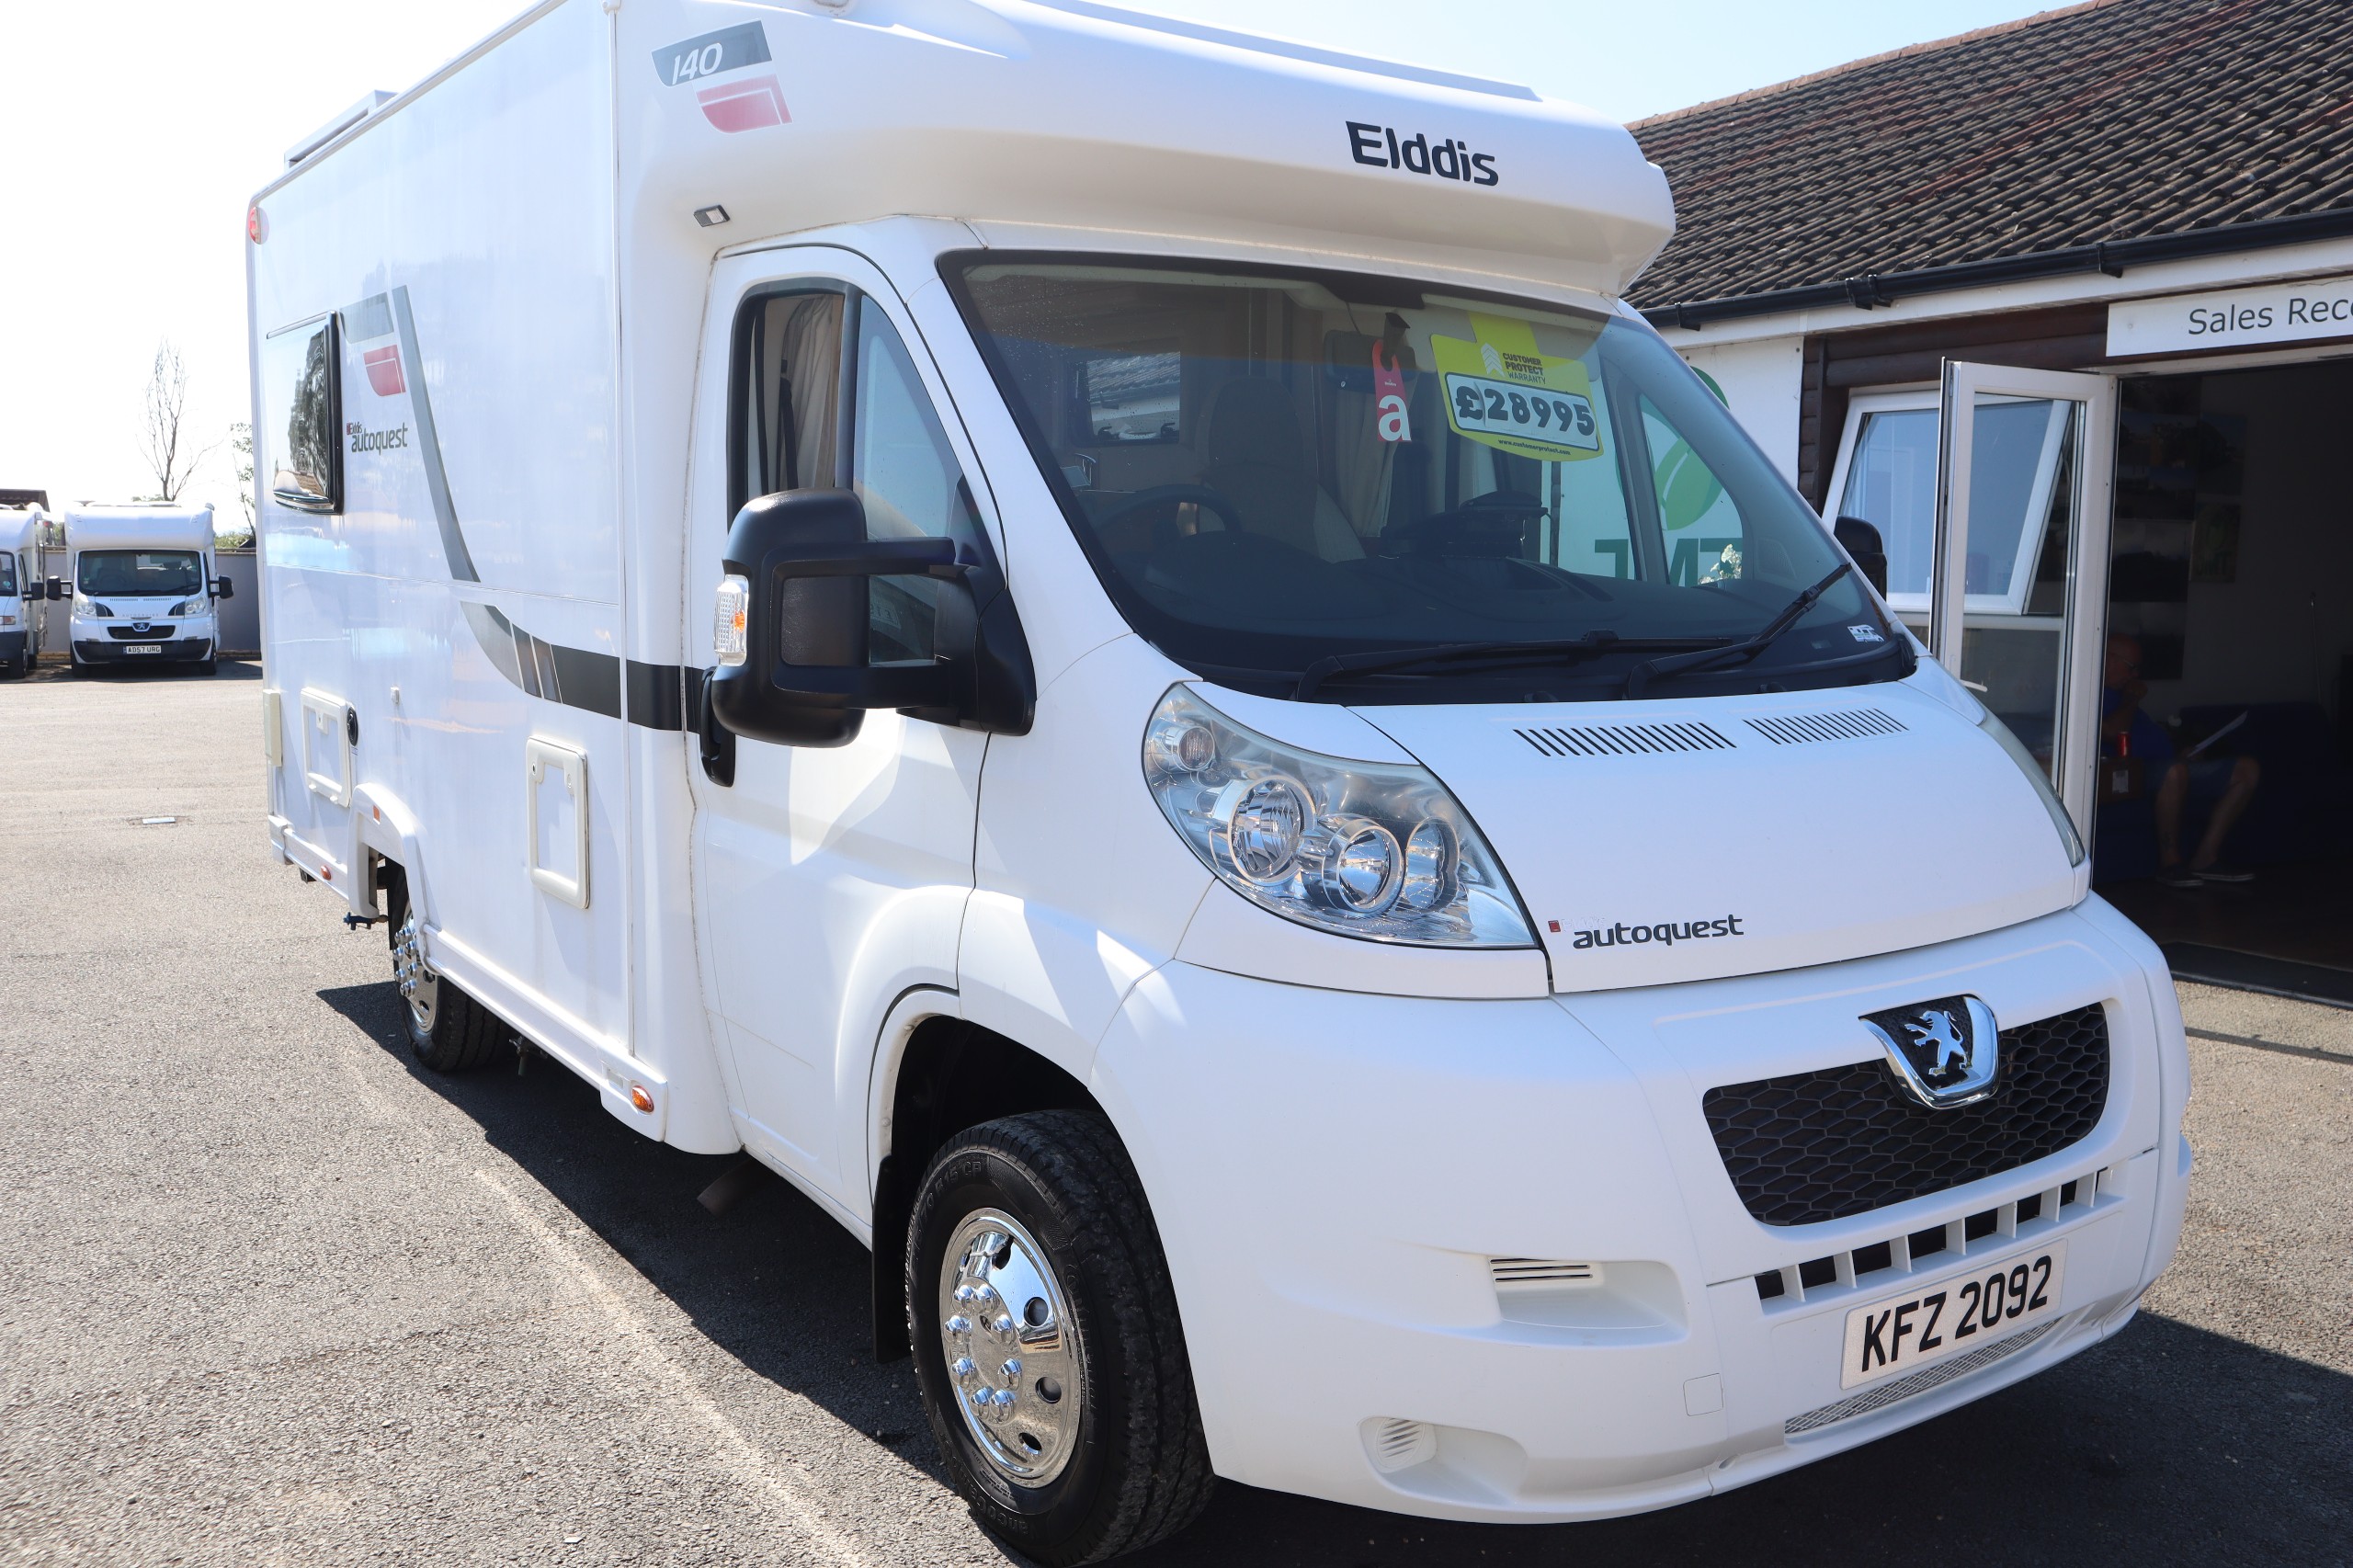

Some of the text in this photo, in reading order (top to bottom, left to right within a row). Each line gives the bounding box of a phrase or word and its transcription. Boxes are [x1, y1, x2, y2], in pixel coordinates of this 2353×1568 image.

[672, 42, 723, 85] 140
[1346, 120, 1499, 187] Elddis
[2188, 298, 2353, 335] Sales Rec
[1503, 353, 1541, 366] CUSTOMER
[1505, 361, 1543, 375] PROTECT
[1507, 371, 1546, 384] WARRANTY
[1378, 394, 1411, 441] a
[1456, 385, 1596, 436] £28995
[351, 422, 408, 456] autoquest
[1498, 439, 1571, 455] www.customerprotect.com
[1573, 915, 1745, 949] autoquest
[1861, 1255, 2052, 1372] KFZ 2092
